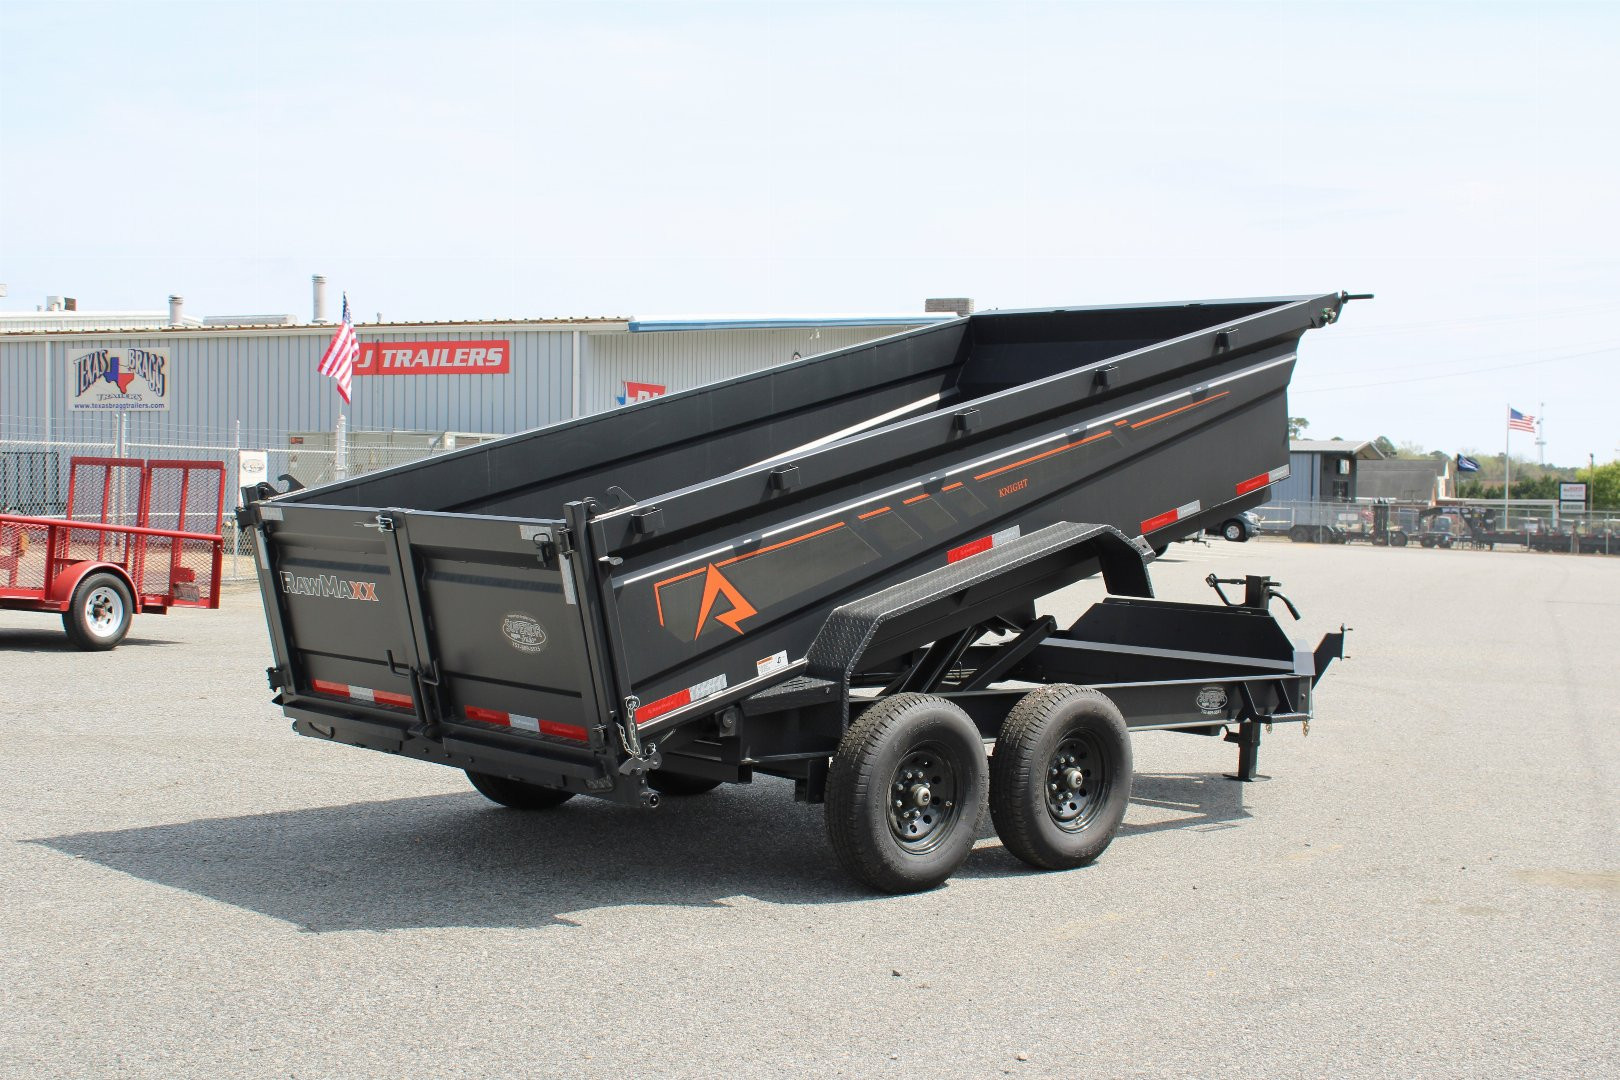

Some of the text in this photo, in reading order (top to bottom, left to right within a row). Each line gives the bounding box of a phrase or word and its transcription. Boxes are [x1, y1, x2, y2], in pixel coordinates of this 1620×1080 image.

[382, 347, 504, 368] TRAILERS
[73, 349, 165, 397] TEXAS BRAGG
[74, 402, 165, 411] www.texasbraggtrailers.com
[97, 393, 142, 401] TRAILERS
[999, 478, 1028, 498] KNIGHT
